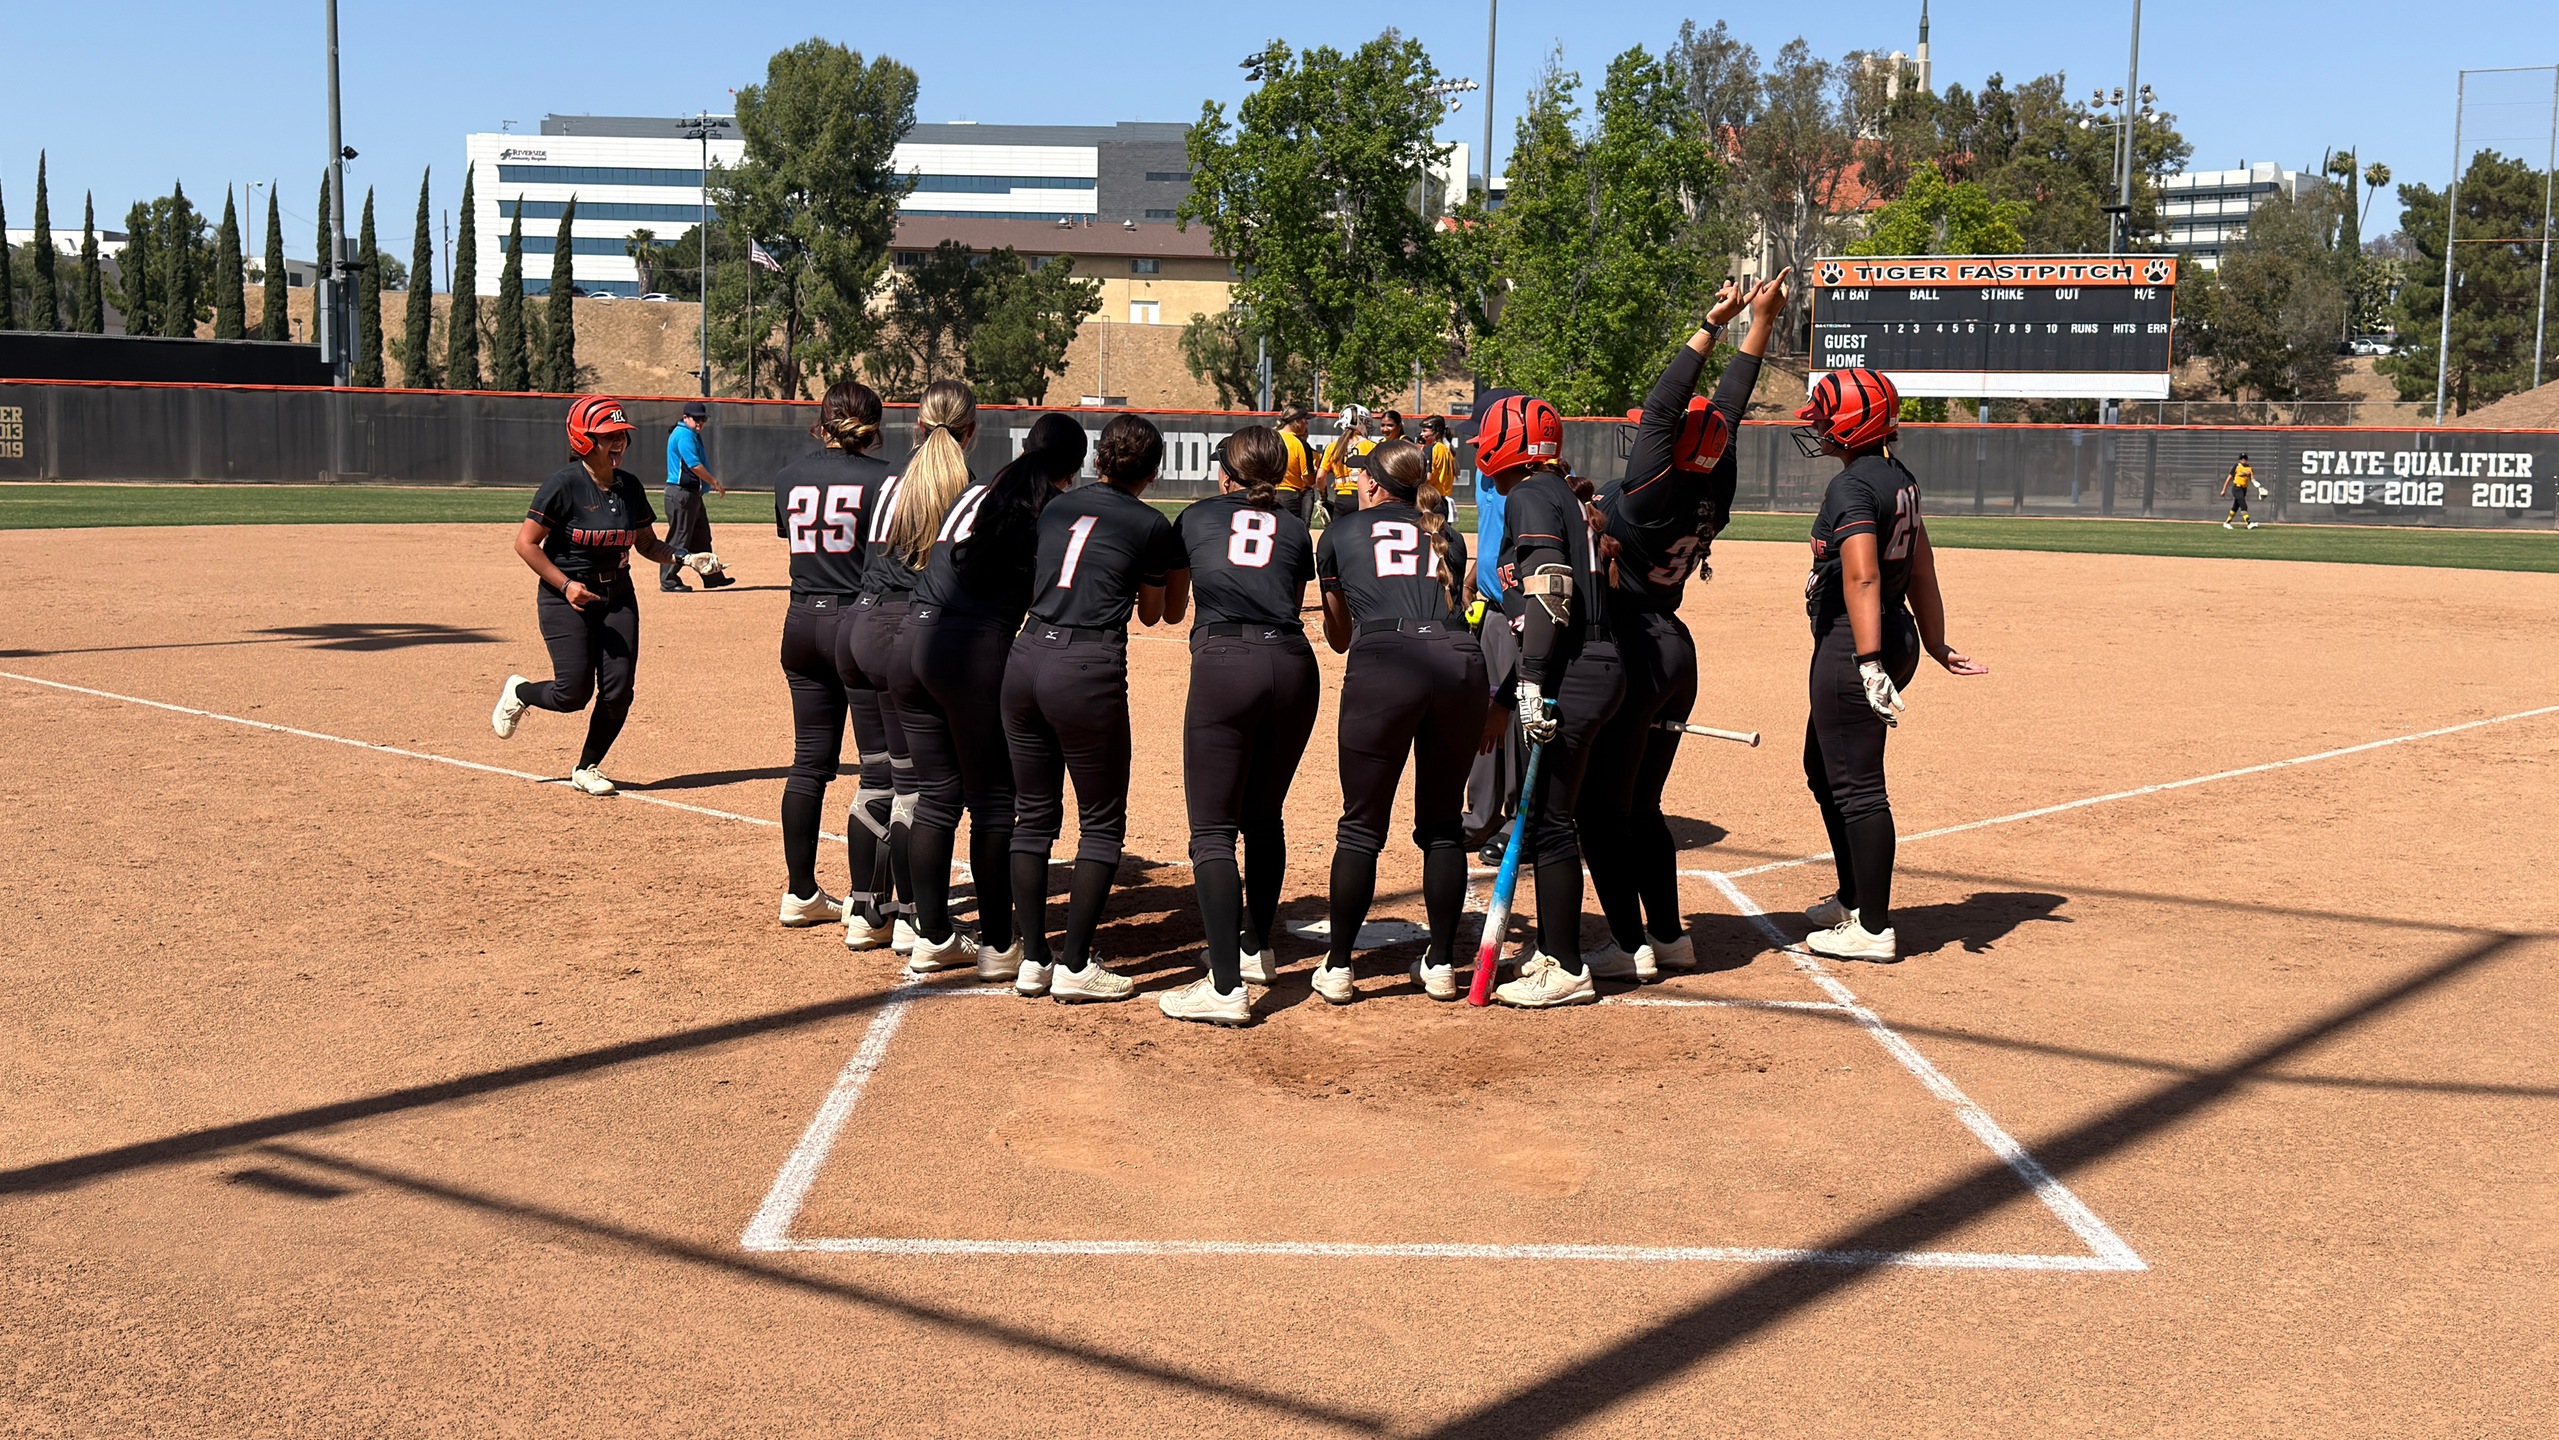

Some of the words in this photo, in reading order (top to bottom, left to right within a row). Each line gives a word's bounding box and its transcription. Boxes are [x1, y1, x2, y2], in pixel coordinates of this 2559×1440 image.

[1853, 265, 1950, 281] TIGER
[1958, 263, 2134, 281] FASTPITCH
[1831, 288, 1846, 301] AT
[1848, 288, 1871, 301] BAT
[1909, 288, 1940, 301] BALL
[1980, 288, 2025, 301] STRIKE
[2055, 288, 2080, 301] OUT
[2134, 287, 2156, 301] H/E
[1883, 323, 1889, 334] 1
[1897, 323, 1905, 334] 2
[1912, 323, 1920, 334] 3
[1936, 323, 1944, 334] 4
[1951, 323, 1960, 334] 5
[1967, 323, 1975, 334] 6
[1993, 323, 2001, 334] 7
[2008, 323, 2016, 334] 8
[2024, 323, 2032, 334] 9
[2045, 323, 2058, 334] 10
[2070, 323, 2099, 334] RUNS
[2112, 323, 2137, 334] HITS
[2146, 323, 2168, 334] ERR
[1824, 334, 1868, 349] GUEST
[1826, 354, 1866, 368] HOME
[1543, 427, 1555, 437] 27
[2301, 450, 2386, 476] STATE
[2393, 451, 2533, 478] QUALIFIER
[2299, 480, 2366, 505] 2009
[2383, 481, 2444, 507] 2012
[2471, 483, 2533, 508] 2013
[787, 485, 863, 554] 25
[1228, 509, 1276, 568] 8
[1056, 515, 1099, 589] 1
